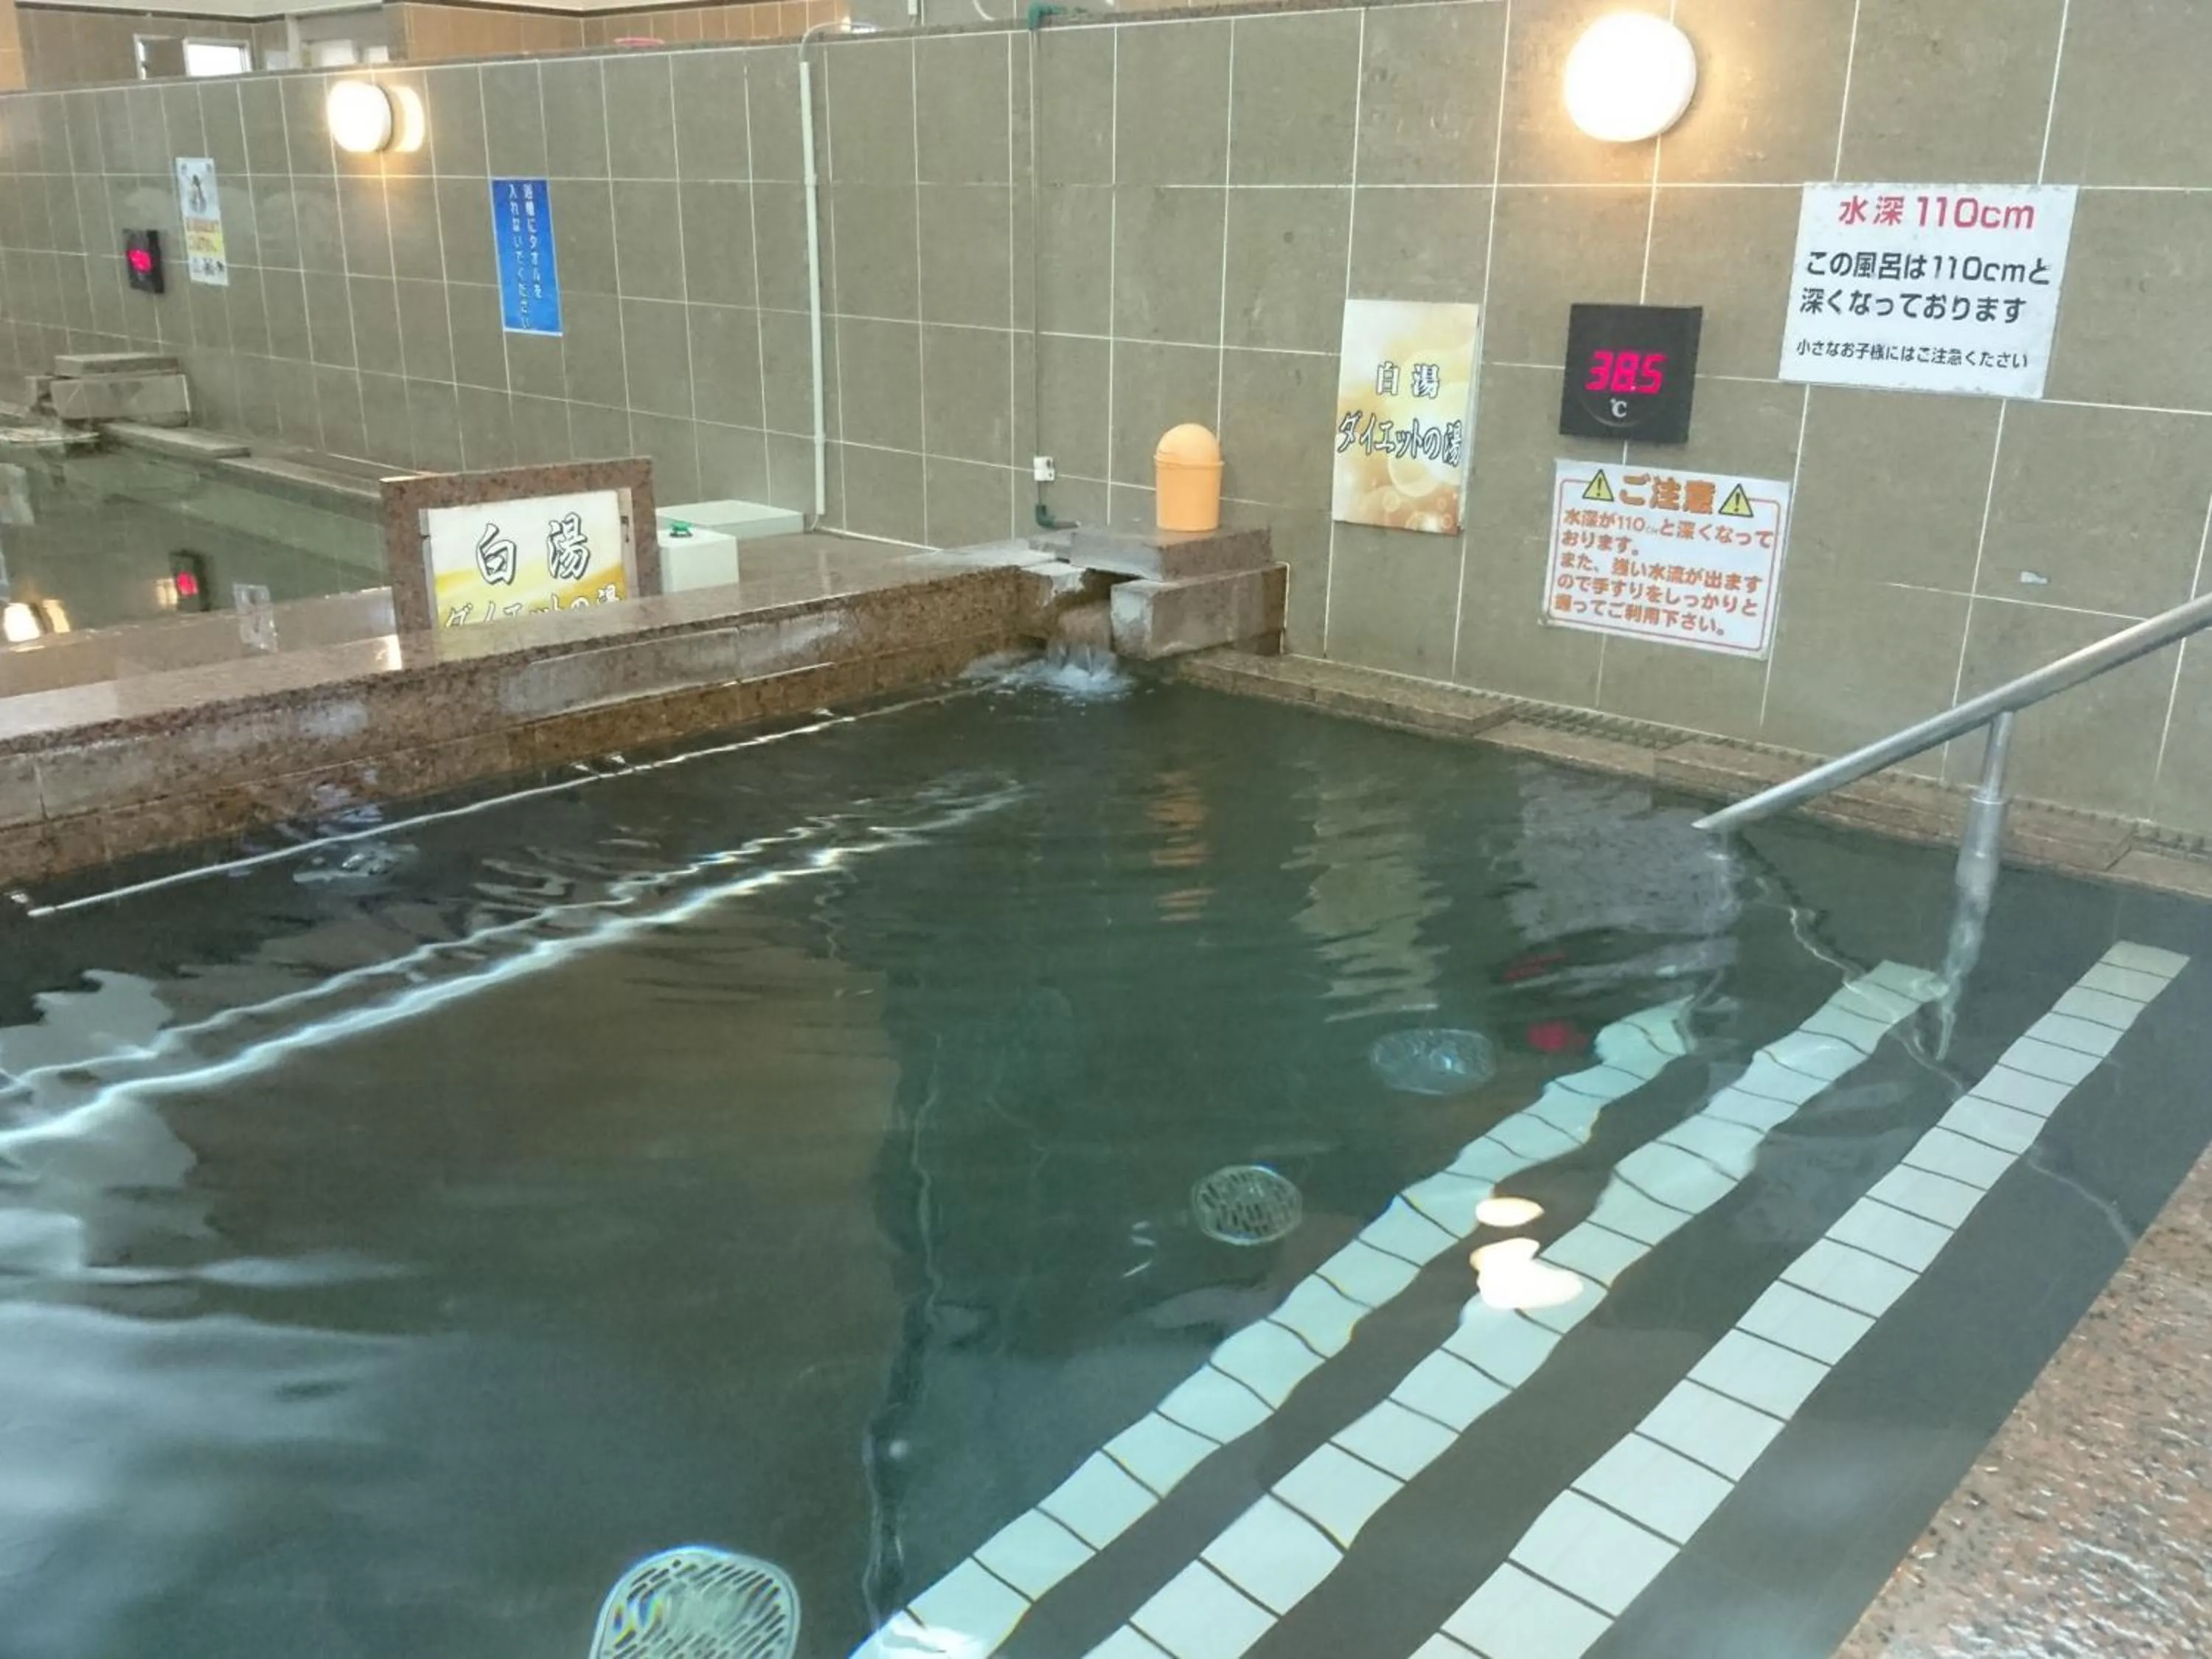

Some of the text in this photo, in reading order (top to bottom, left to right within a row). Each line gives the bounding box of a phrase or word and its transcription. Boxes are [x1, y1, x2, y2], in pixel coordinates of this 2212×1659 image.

[1838, 195, 2035, 229] 水深 110cm
[1806, 251, 2051, 285] この風呂は110cmと
[1799, 287, 2027, 324] 深くなっております
[1796, 338, 2028, 369] 小さなお子様にはご注意ください
[1374, 361, 1440, 400] 白湯
[1337, 410, 1463, 468] ダイエットの湯
[1618, 472, 1717, 515] ご注意
[476, 511, 591, 585] 白湯
[1561, 529, 1639, 556] おります。
[1557, 573, 1758, 616] ので手すりをしっかりと
